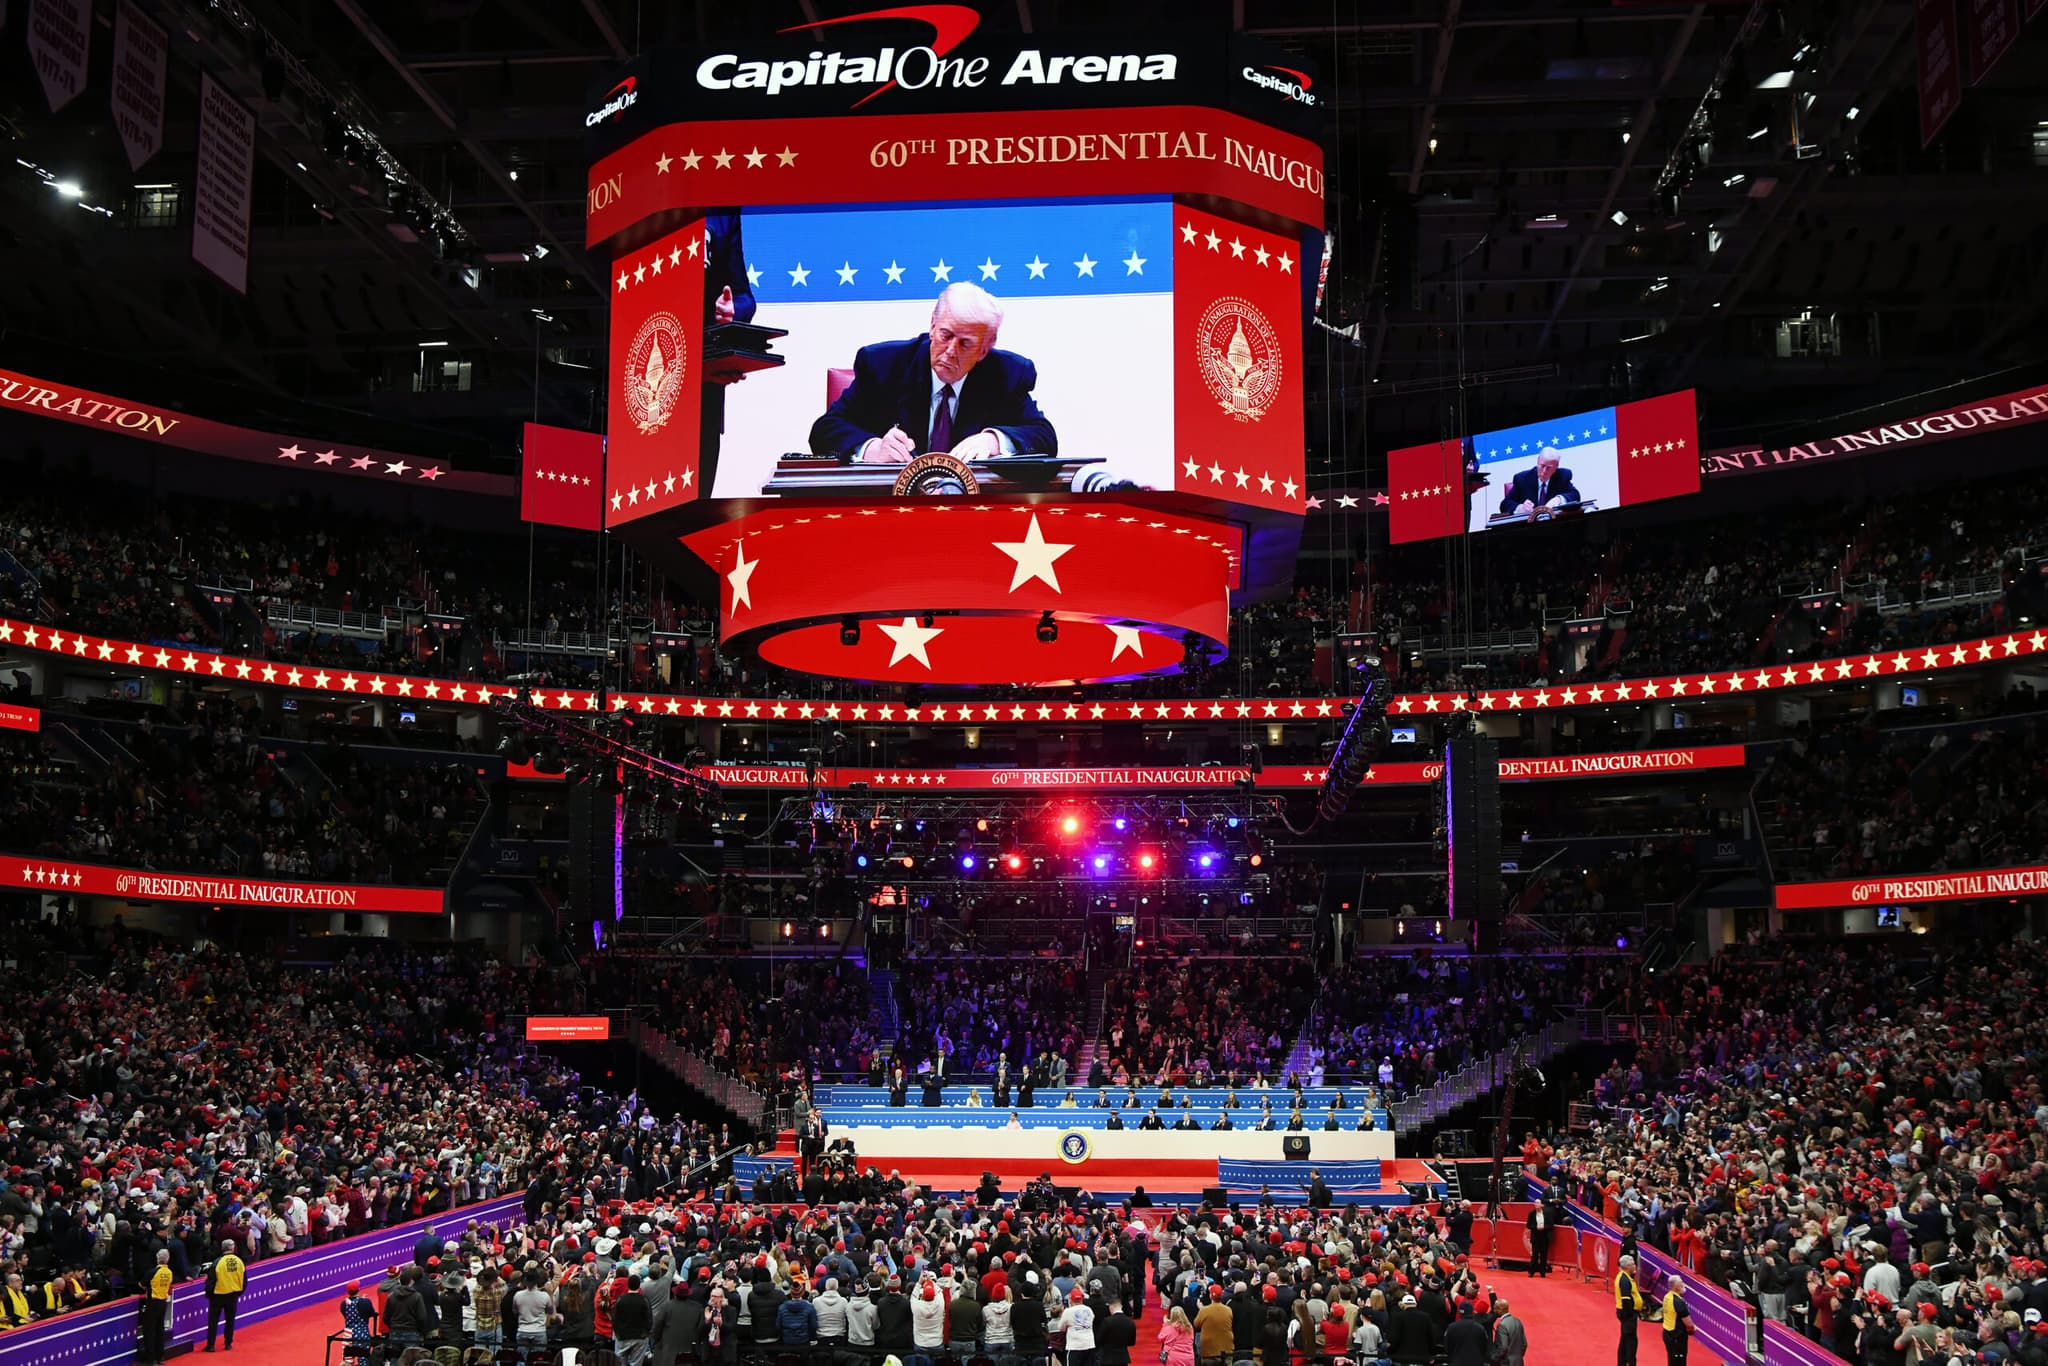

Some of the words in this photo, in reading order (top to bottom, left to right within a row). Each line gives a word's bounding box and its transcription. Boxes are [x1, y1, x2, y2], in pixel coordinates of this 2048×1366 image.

[33, 18, 81, 67] CHAMPIONS
[1001, 50, 1178, 86] Arena
[204, 97, 251, 147] CHAMPIONS
[211, 86, 247, 128] DIVISION
[870, 139, 936, 168] 60TH
[947, 131, 1217, 165] PRESIDENTIAL
[1223, 136, 1324, 200] INAUGU
[587, 172, 623, 219] ION
[1209, 304, 1261, 327] INAUGURATION
[1260, 325, 1270, 338] OF
[1233, 411, 1249, 422] 2025
[991, 771, 1020, 785] 60TH
[1023, 770, 1133, 784] PRESIDENTIAL
[1571, 751, 1694, 772] INAUGURATION
[116, 873, 137, 892] 60TH
[138, 876, 237, 900] PRESIDENTIAL
[240, 884, 357, 905] INAUGURATION
[1852, 883, 1881, 901] 60TH
[1884, 876, 1985, 899] PRESIDENTIAL
